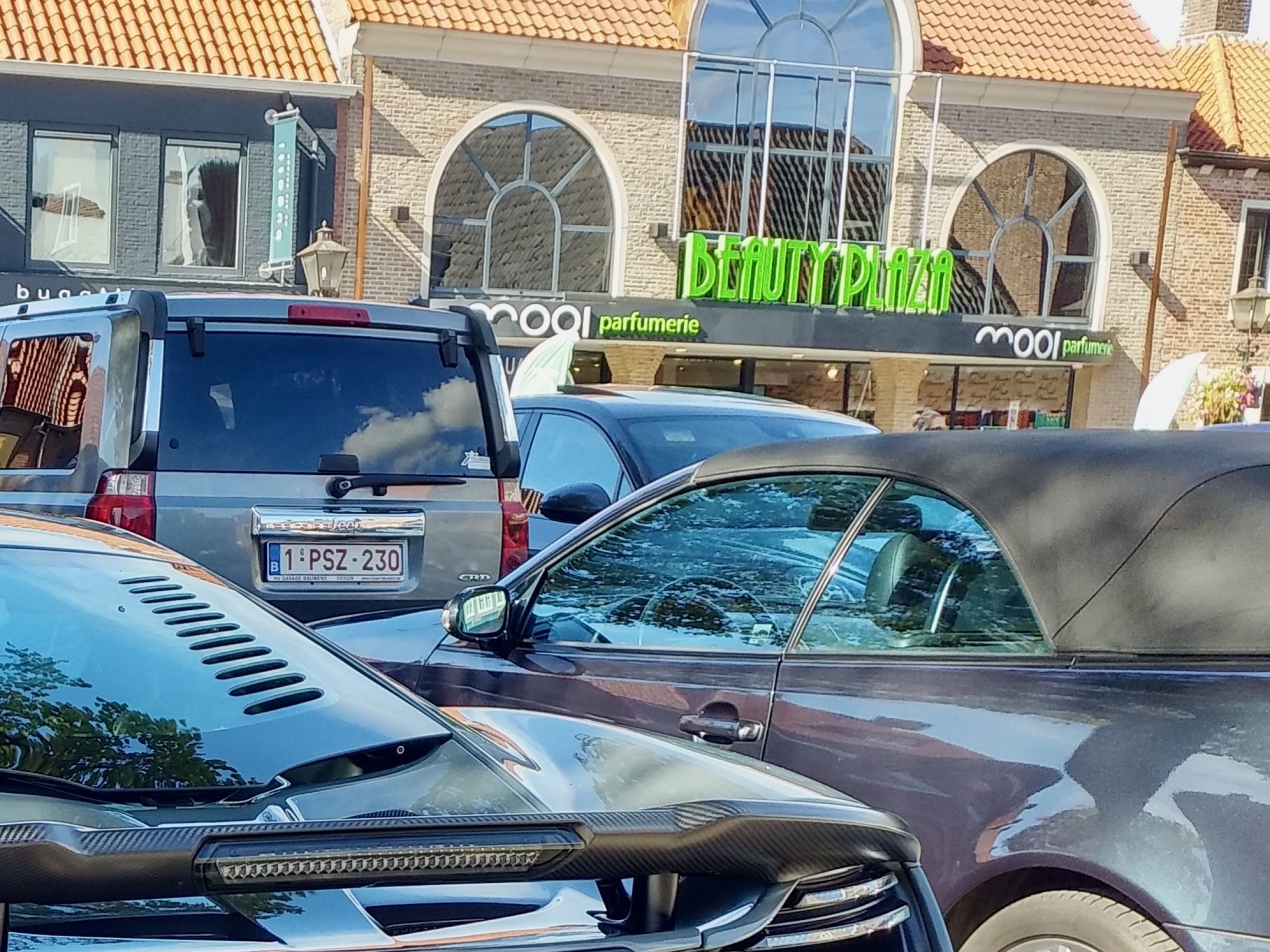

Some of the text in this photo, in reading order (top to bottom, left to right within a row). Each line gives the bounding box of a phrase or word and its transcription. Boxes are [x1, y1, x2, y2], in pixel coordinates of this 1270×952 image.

[684, 232, 954, 315] BEAUTY PLAZA
[598, 311, 700, 335] parfumerie
[1062, 335, 1114, 358] parfumerie
[270, 561, 279, 572] B
[458, 573, 491, 582] CRD
